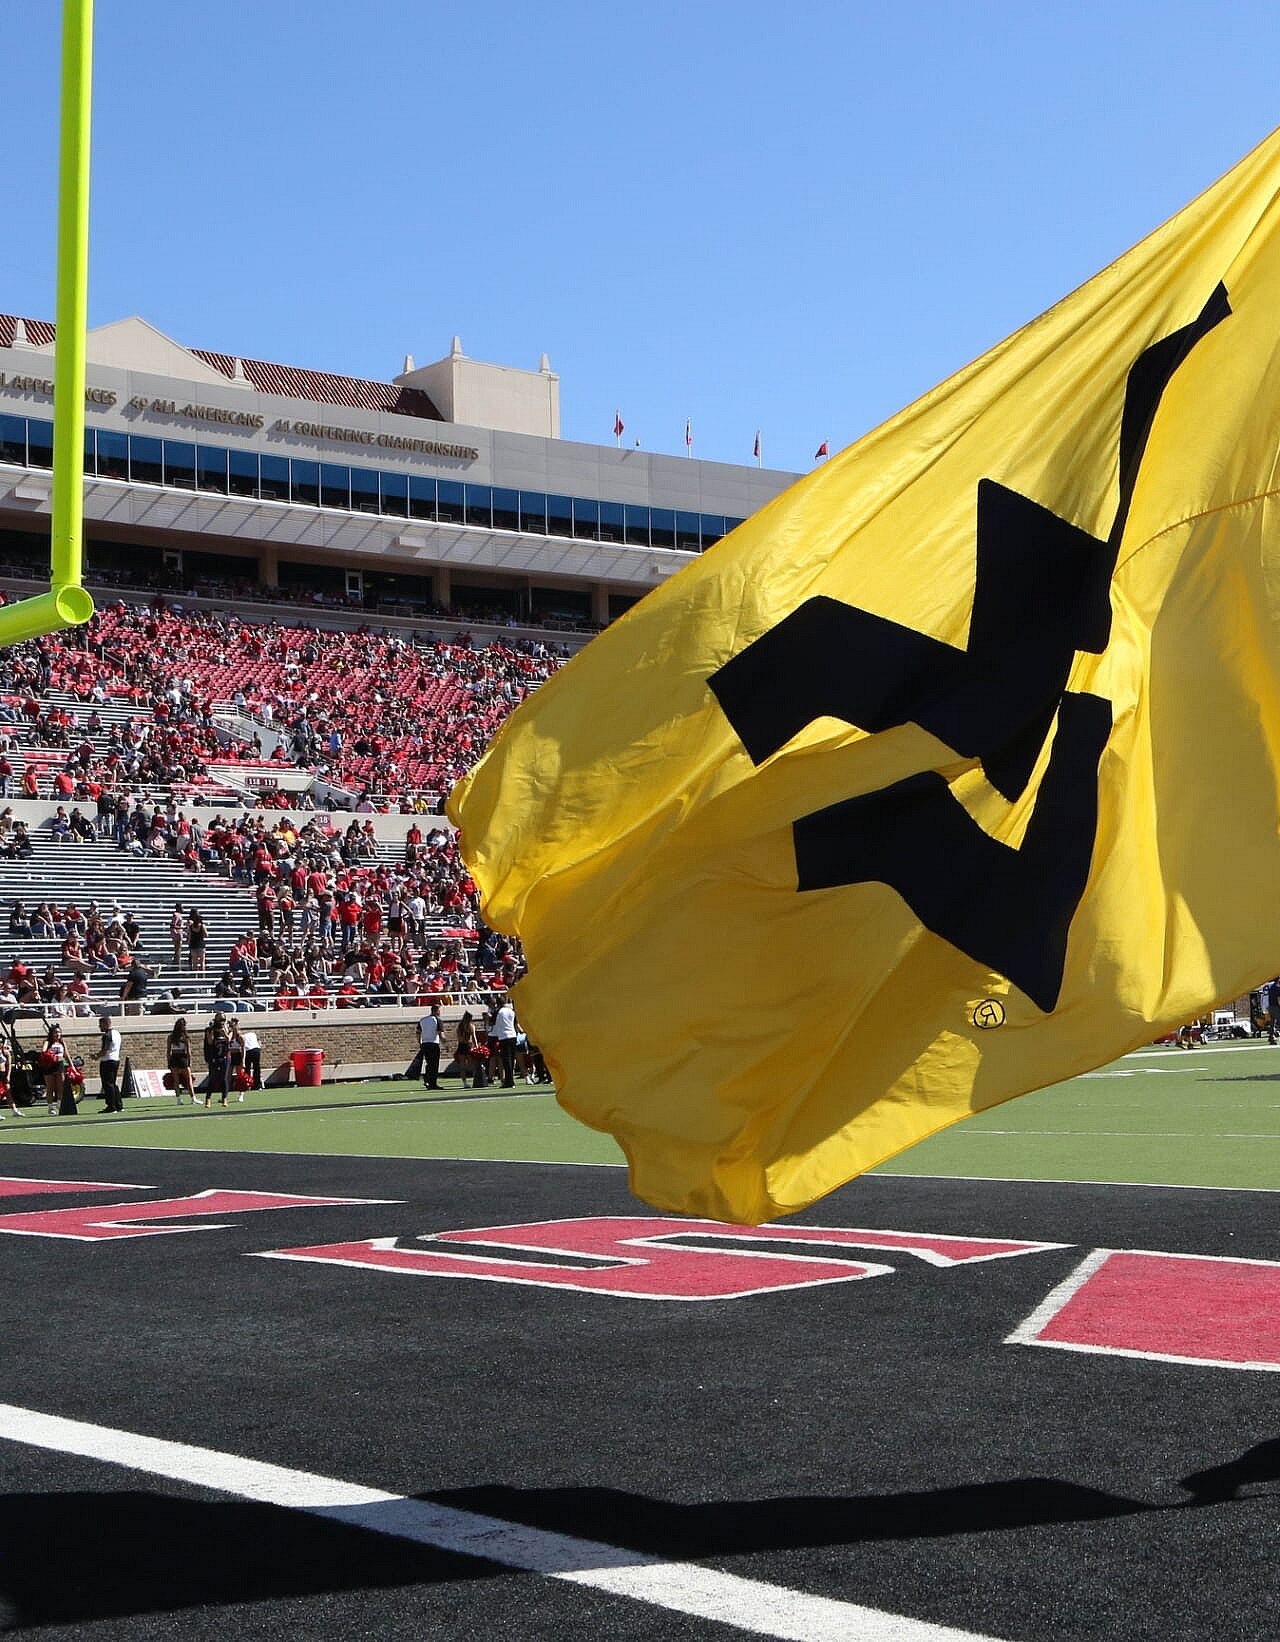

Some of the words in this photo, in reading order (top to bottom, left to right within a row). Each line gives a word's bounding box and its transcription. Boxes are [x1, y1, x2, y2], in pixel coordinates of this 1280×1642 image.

[13, 374, 117, 406] APPENCES
[152, 399, 265, 428] ALL-AMERICANS
[294, 421, 375, 445] CONFERENCE
[377, 434, 480, 460] CHAMPIONSHIPS
